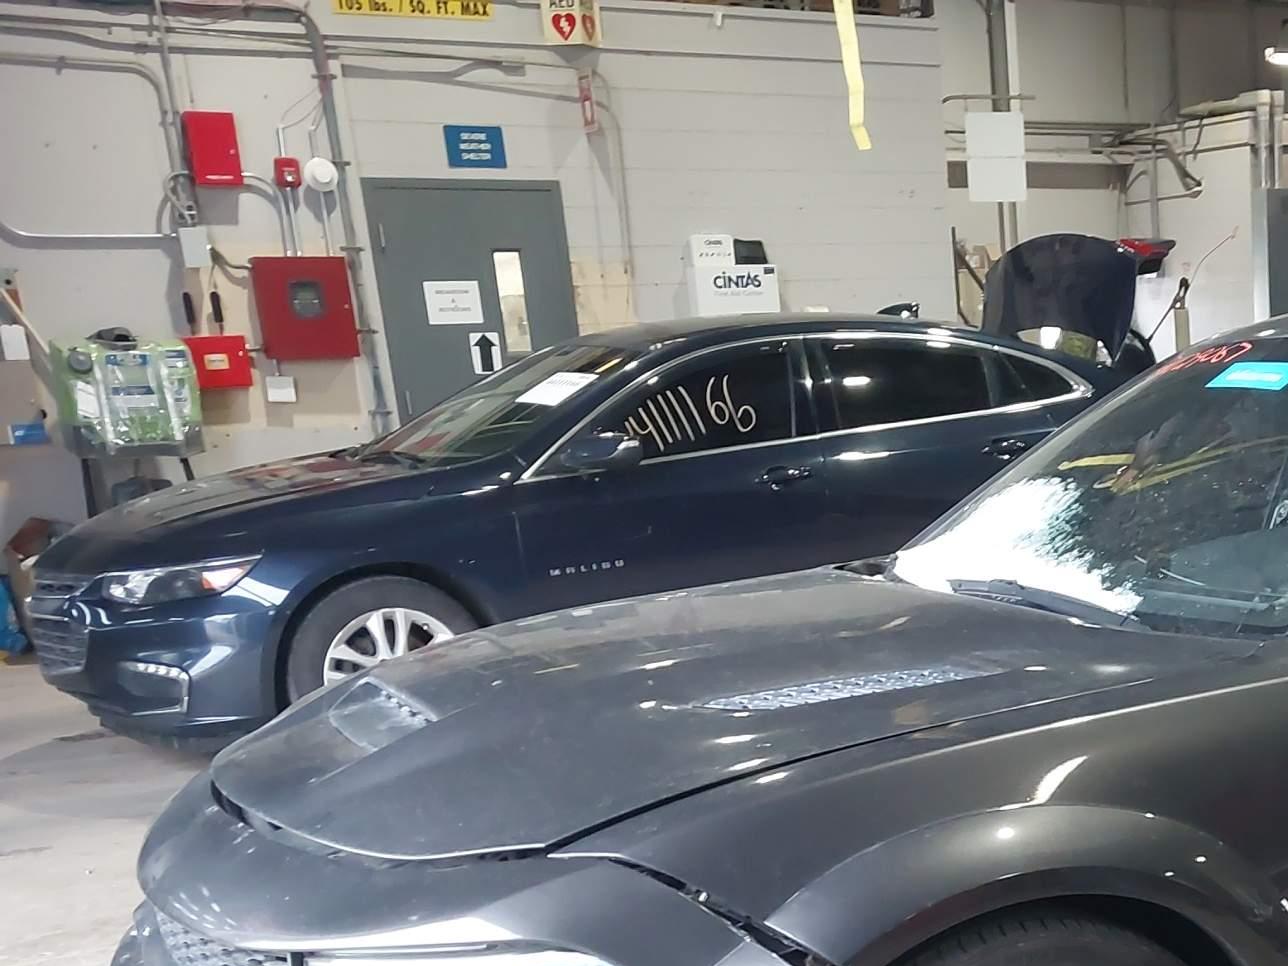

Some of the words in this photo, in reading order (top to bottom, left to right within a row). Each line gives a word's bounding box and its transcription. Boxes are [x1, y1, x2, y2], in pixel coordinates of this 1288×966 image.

[408, 0, 431, 15] SQ.
[436, 0, 455, 15] FT.
[460, 1, 489, 17] MAX
[713, 271, 762, 289] CINTAS
[549, 559, 625, 577] MALIBU
